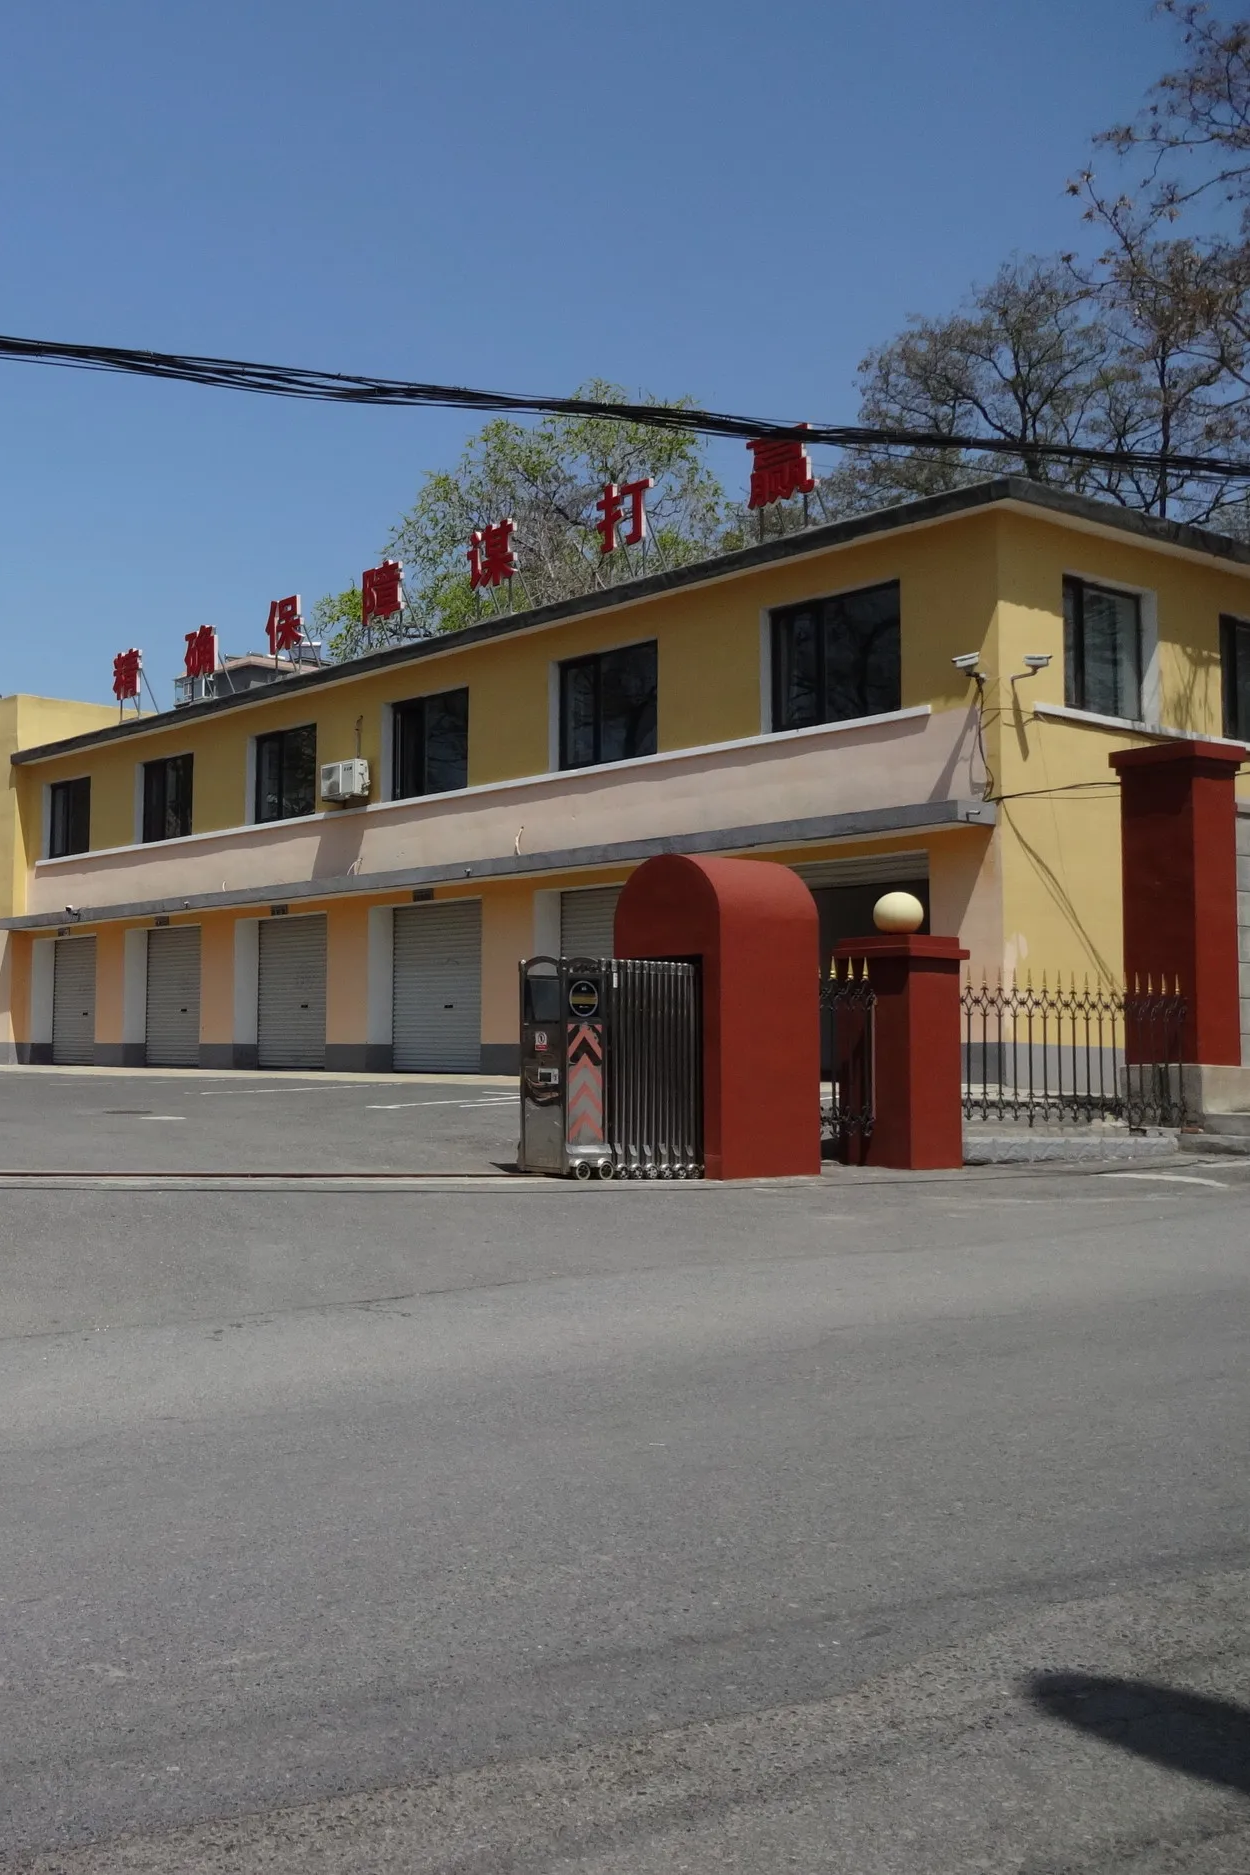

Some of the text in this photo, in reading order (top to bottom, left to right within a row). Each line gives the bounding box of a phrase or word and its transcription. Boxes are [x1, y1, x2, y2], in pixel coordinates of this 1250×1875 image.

[113, 422, 818, 701] 精确保障谋打赢
